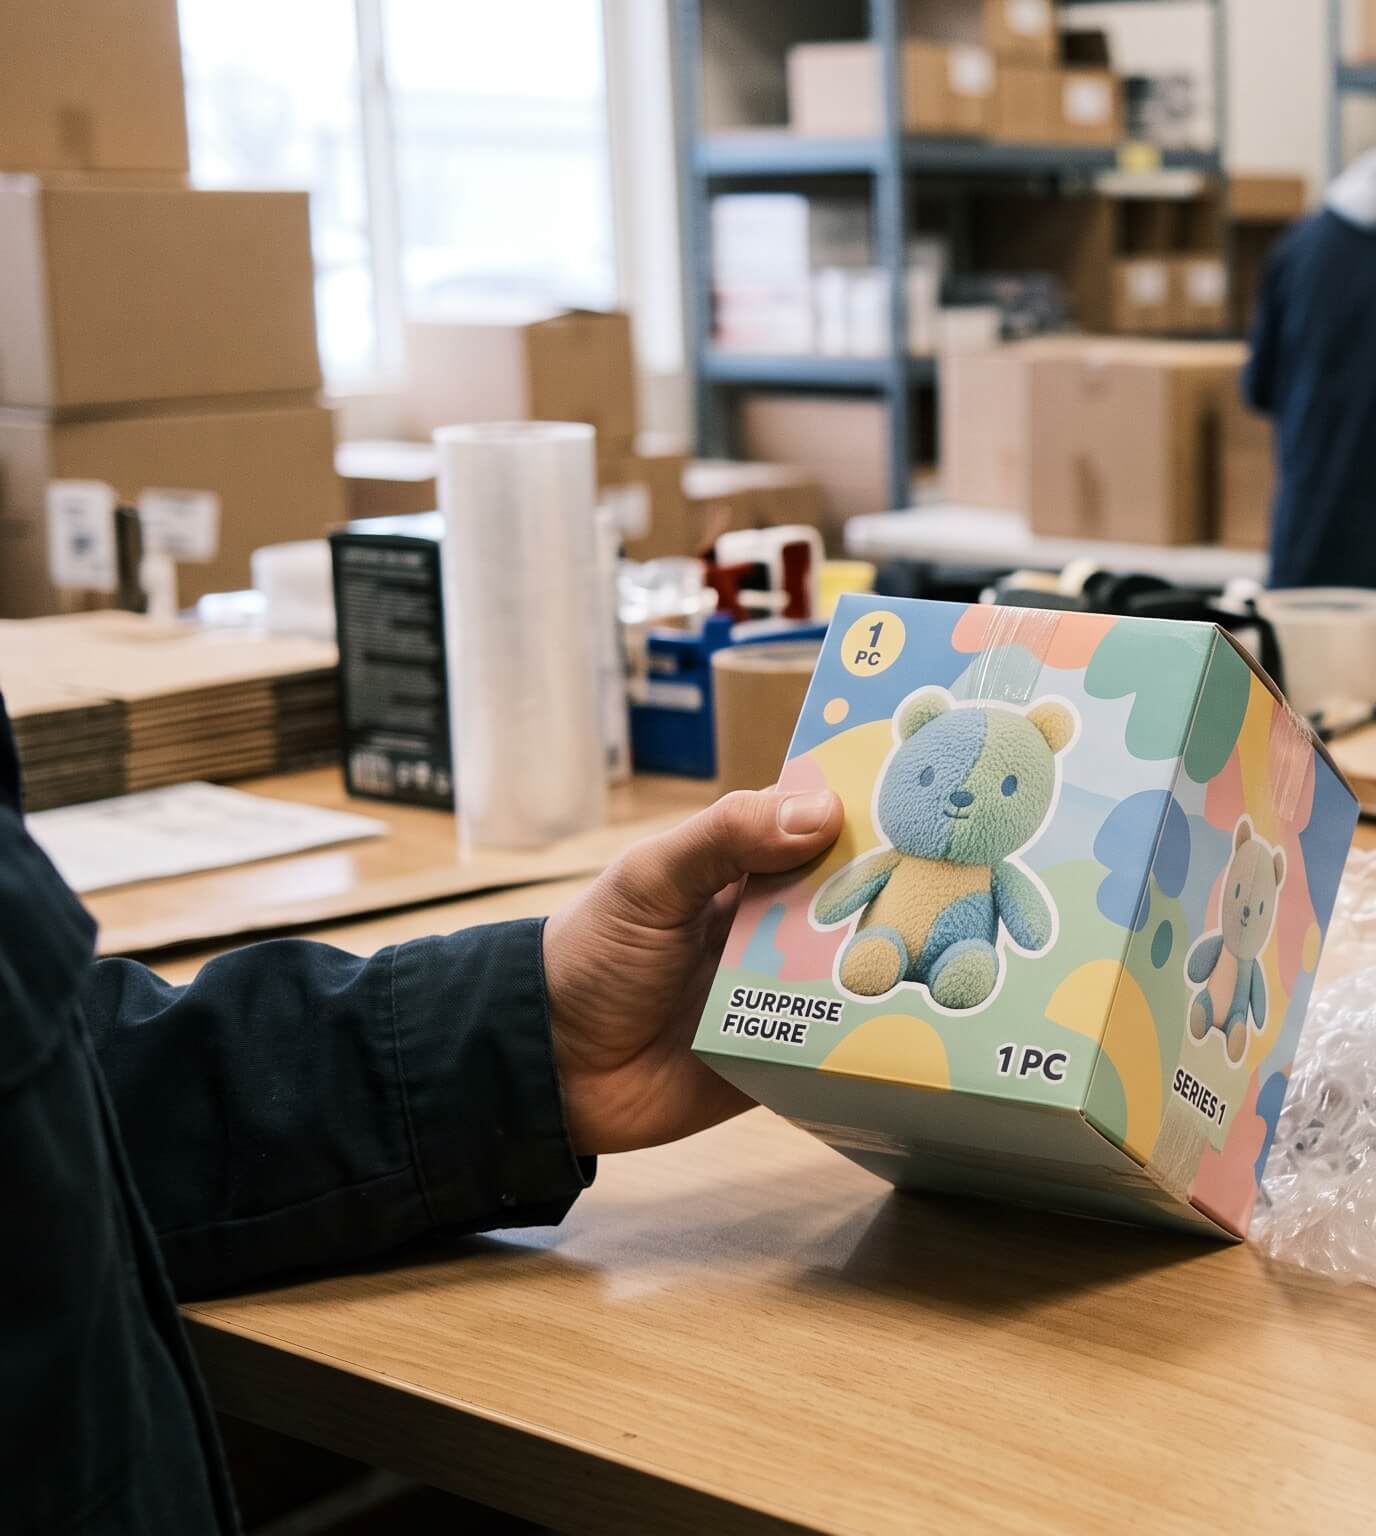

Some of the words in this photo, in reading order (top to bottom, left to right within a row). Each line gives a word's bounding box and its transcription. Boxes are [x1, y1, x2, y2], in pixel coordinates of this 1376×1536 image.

[869, 622, 884, 648] 1
[854, 650, 881, 666] PC
[730, 988, 842, 1022] SURPRISE
[722, 1013, 807, 1044] FIGURE
[999, 1046, 1014, 1073] 1
[1019, 1048, 1067, 1081] PC
[1173, 1068, 1218, 1119] SERIES
[1218, 1103, 1226, 1125] 1
